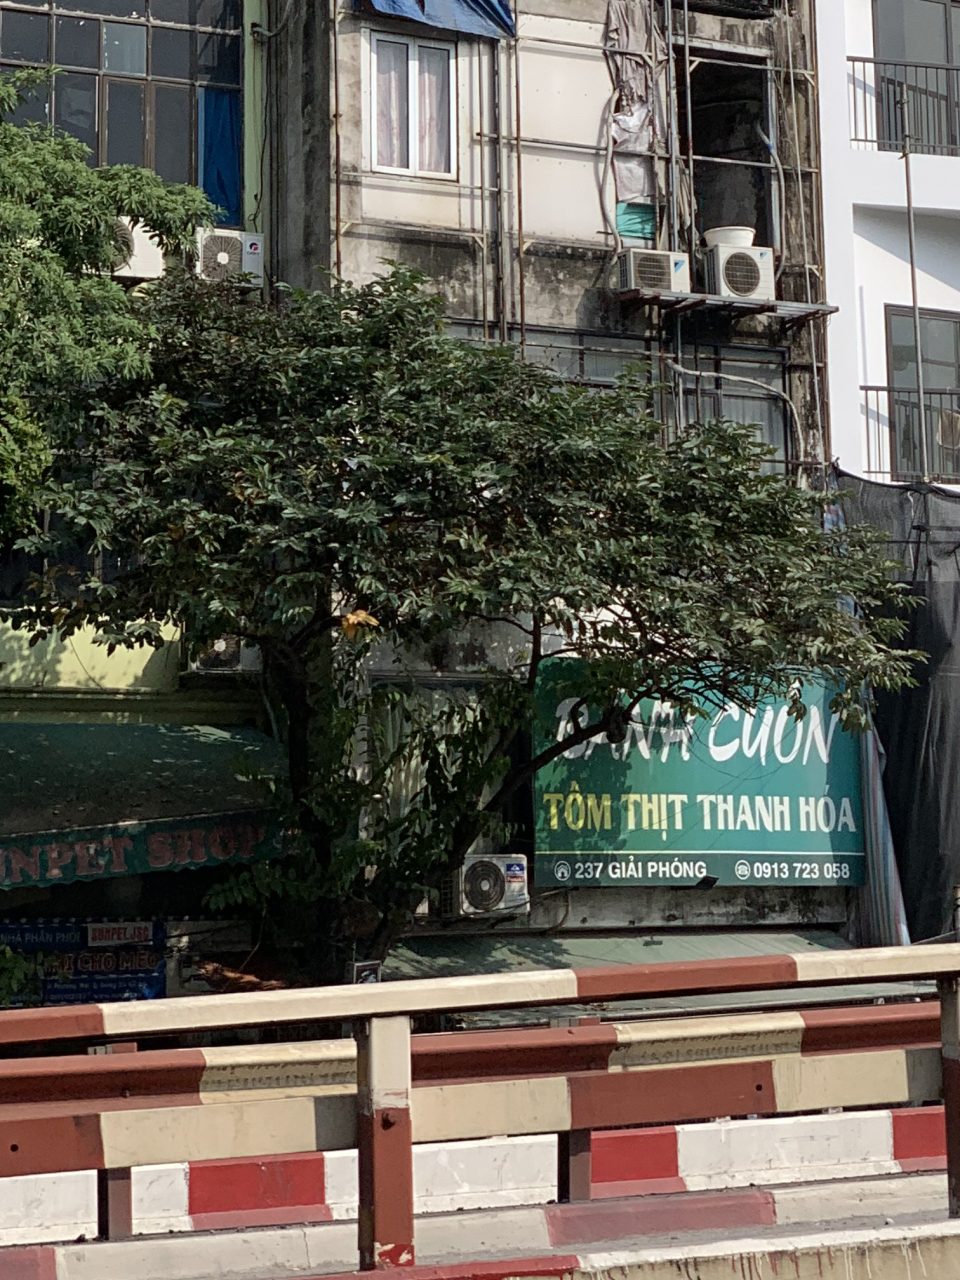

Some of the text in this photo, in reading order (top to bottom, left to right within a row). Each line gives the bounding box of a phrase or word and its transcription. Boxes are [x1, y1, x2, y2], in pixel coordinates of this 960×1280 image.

[543, 780, 857, 841] TÔM THỊT THANH HÓA
[574, 855, 707, 879] 237 GIẢI PHÓNG
[754, 861, 851, 879] 0913 723 058
